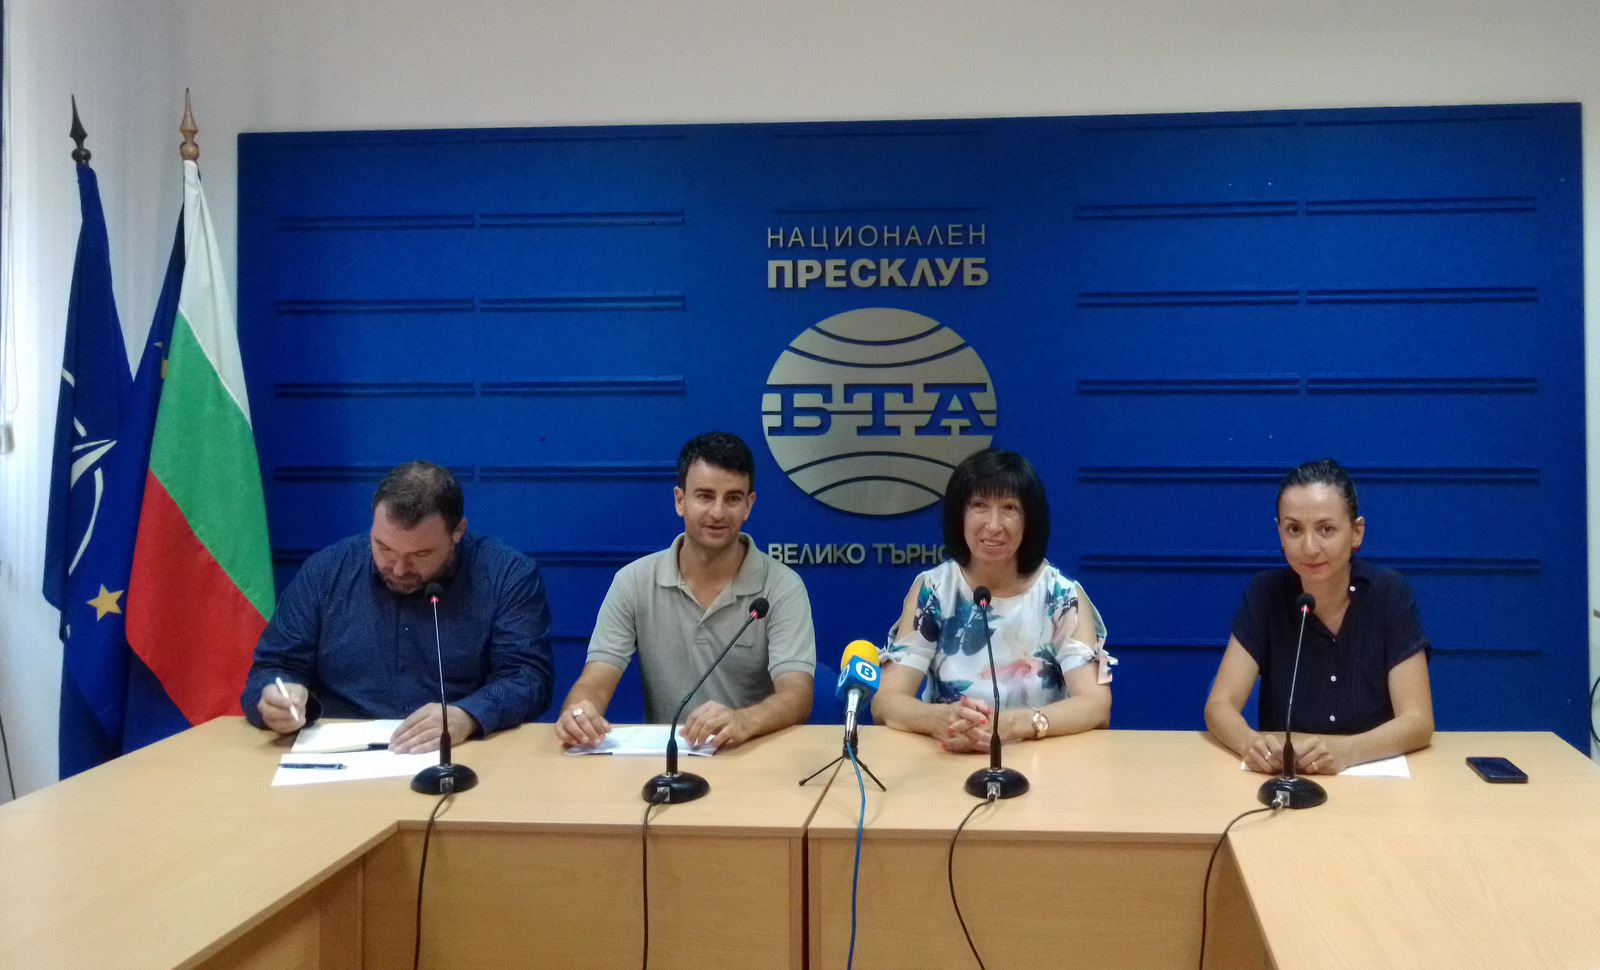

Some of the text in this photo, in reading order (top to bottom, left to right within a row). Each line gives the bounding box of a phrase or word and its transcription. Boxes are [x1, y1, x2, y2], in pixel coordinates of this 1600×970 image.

[767, 224, 986, 250] НАЦИОНАЛЕН
[767, 257, 989, 288] ПРЕСКЛУБ
[765, 383, 993, 436] БТА
[768, 543, 866, 565] ВЕЛИКО
